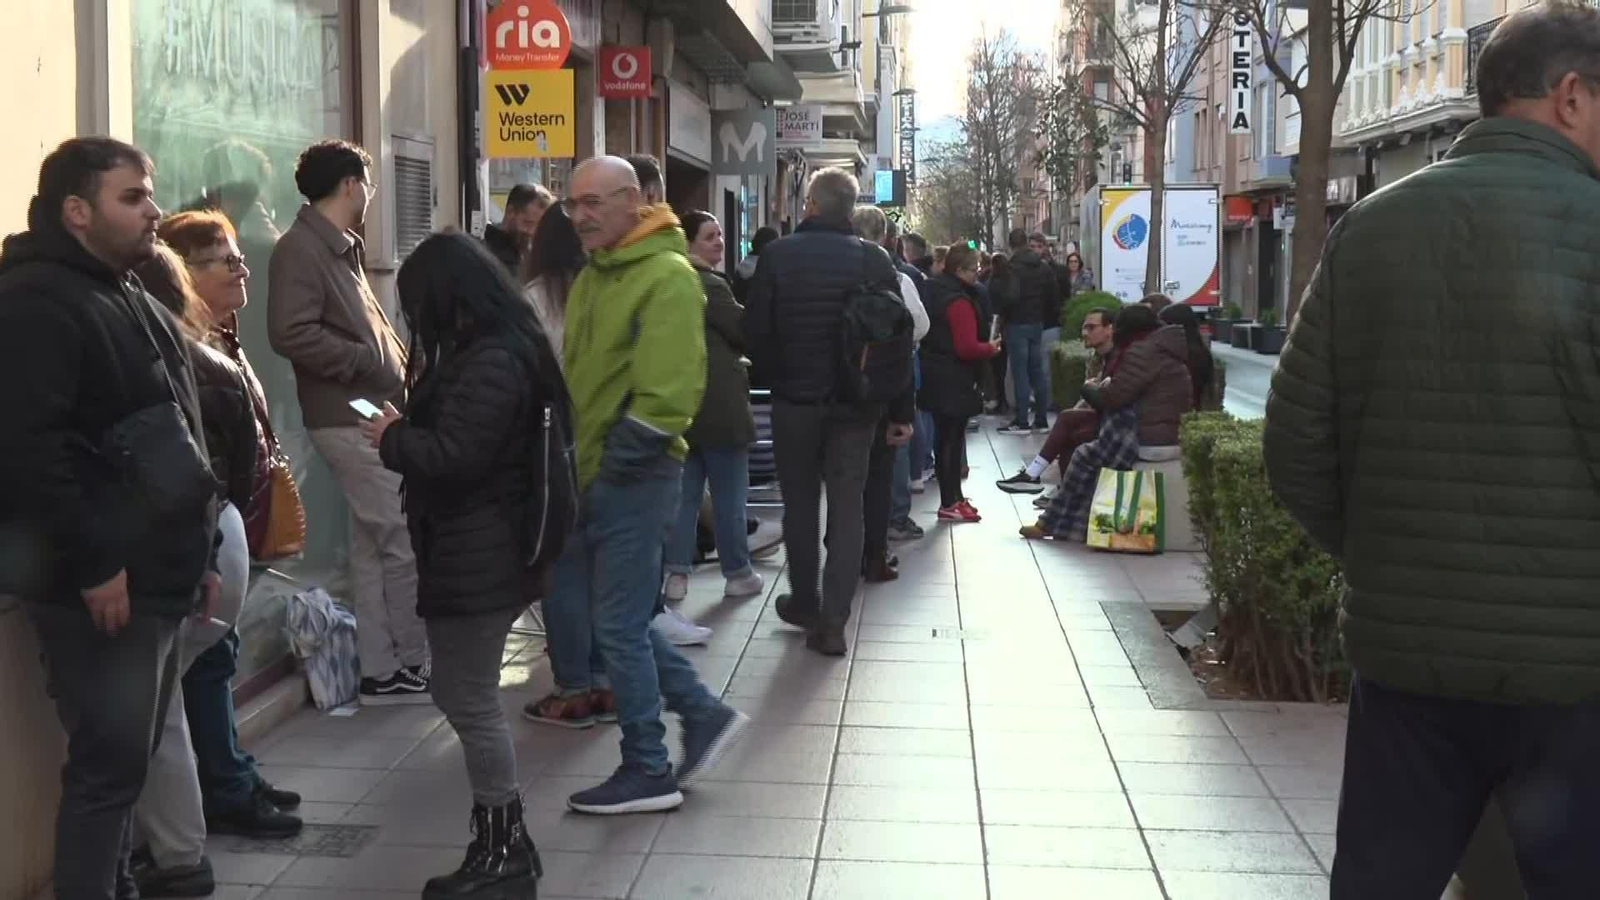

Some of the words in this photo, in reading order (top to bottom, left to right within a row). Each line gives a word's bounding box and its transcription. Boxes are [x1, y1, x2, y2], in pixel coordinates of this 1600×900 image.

[495, 5, 560, 48] ria
[496, 53, 525, 63] Money
[526, 53, 560, 62] Transfer
[604, 81, 647, 91] vodafone
[499, 112, 566, 127] Western
[499, 127, 547, 142] Union
